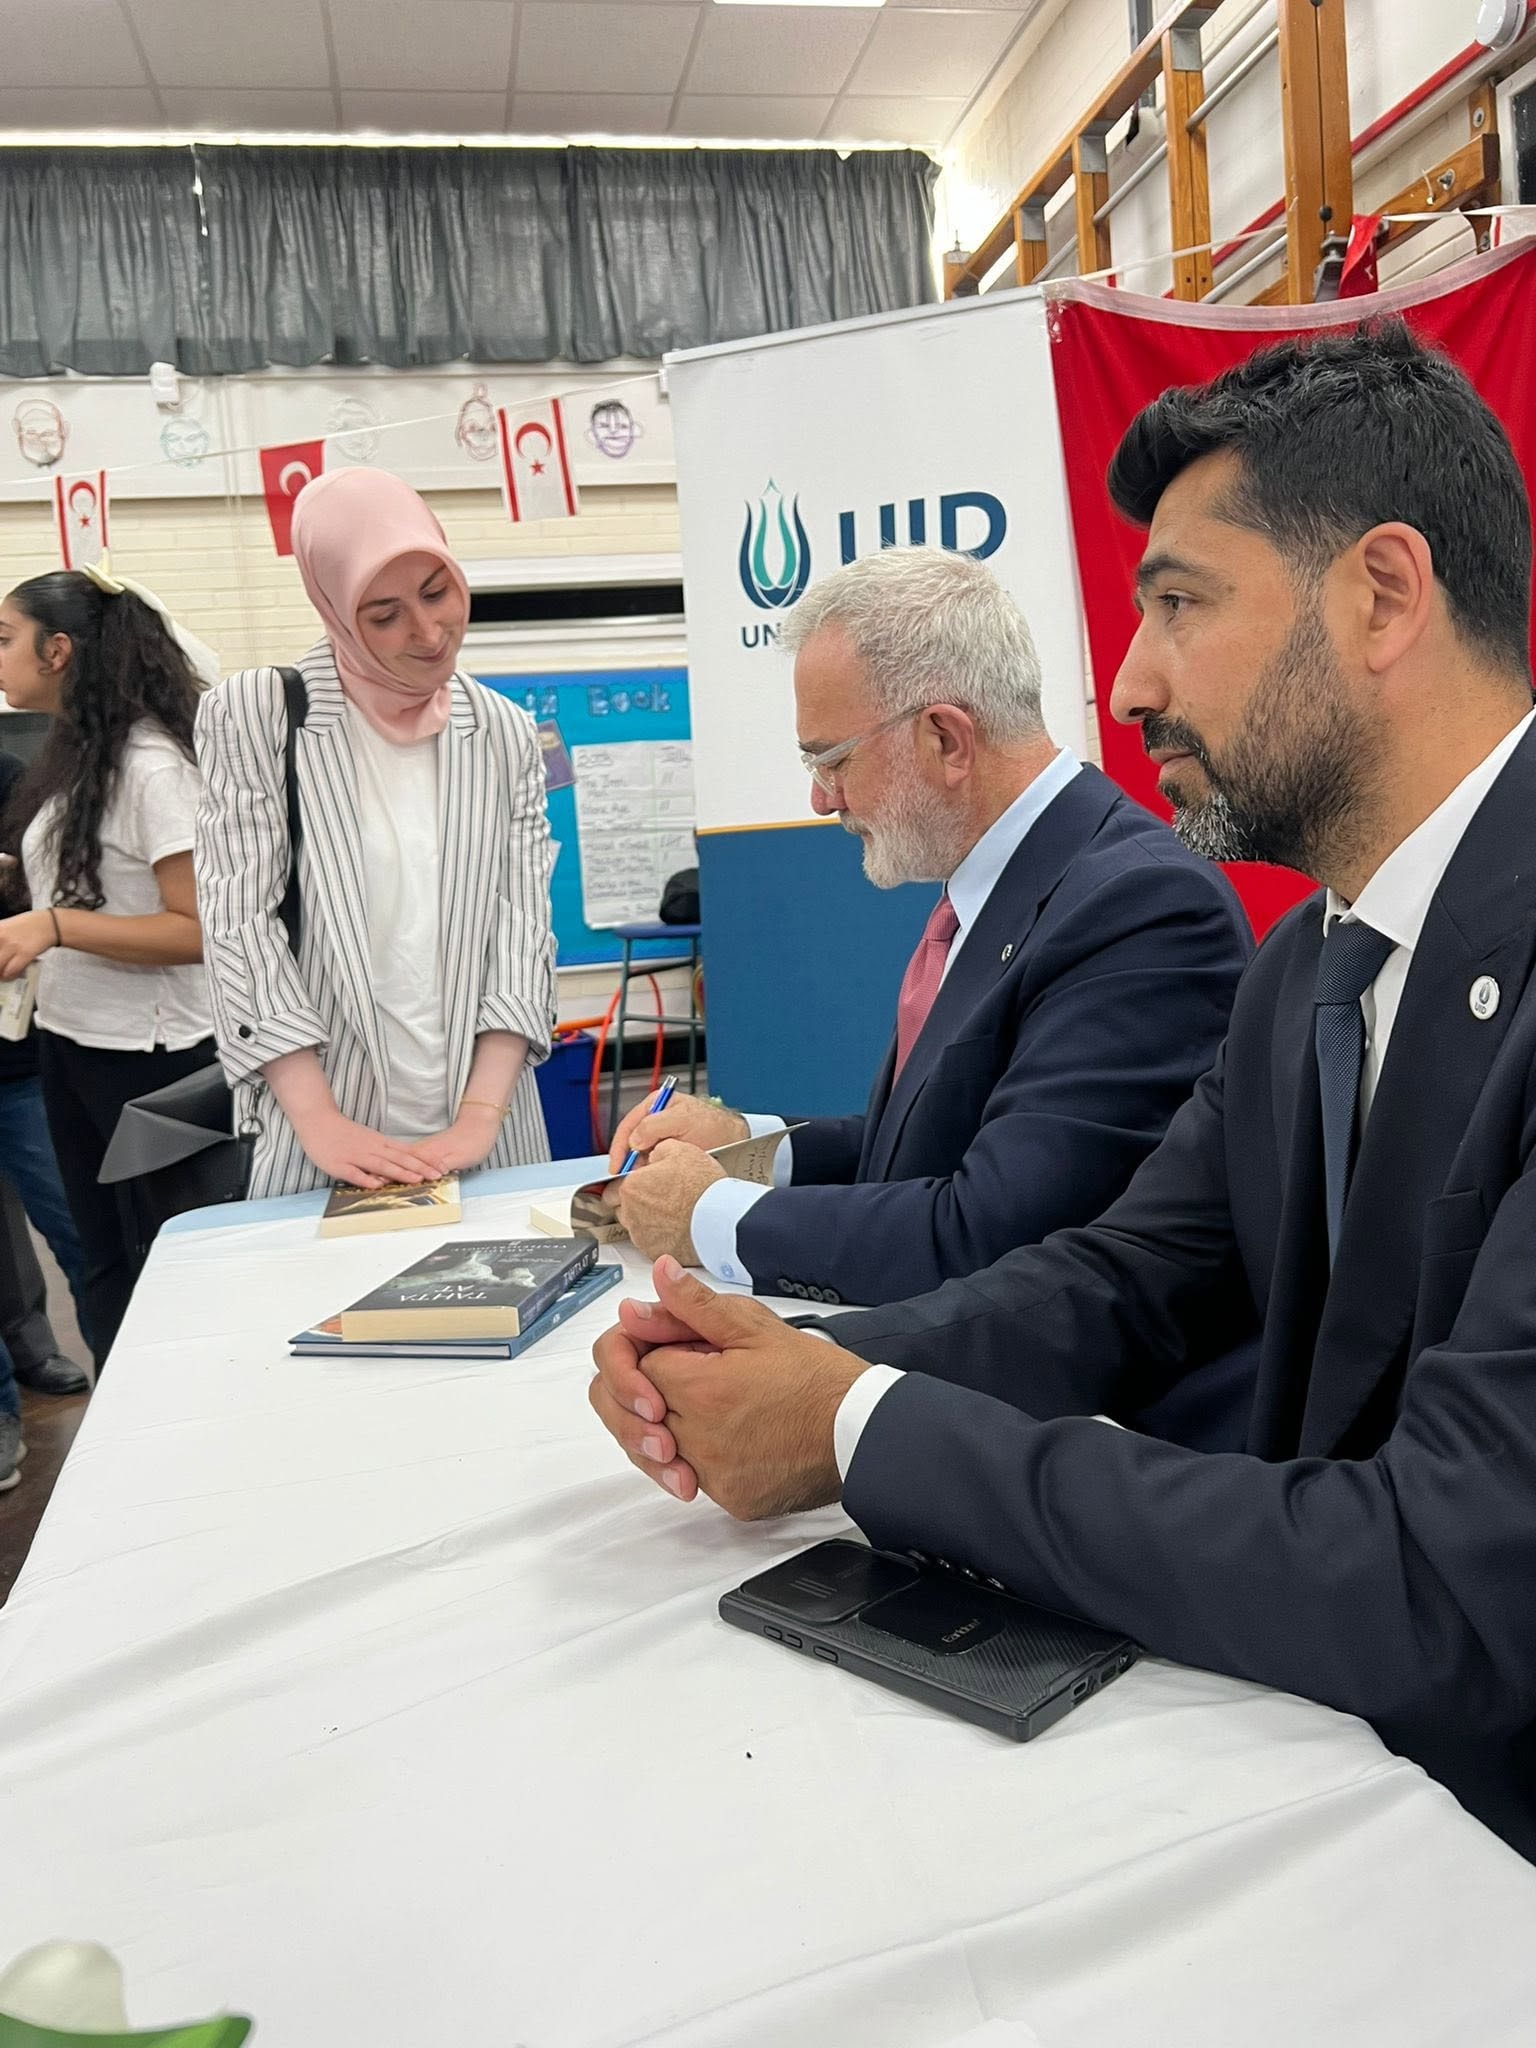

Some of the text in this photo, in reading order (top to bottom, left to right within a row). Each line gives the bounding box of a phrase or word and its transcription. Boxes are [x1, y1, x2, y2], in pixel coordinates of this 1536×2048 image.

[588, 684, 672, 716] Book
[435, 1284, 475, 1292] AT
[401, 1292, 487, 1302] TAHTA
